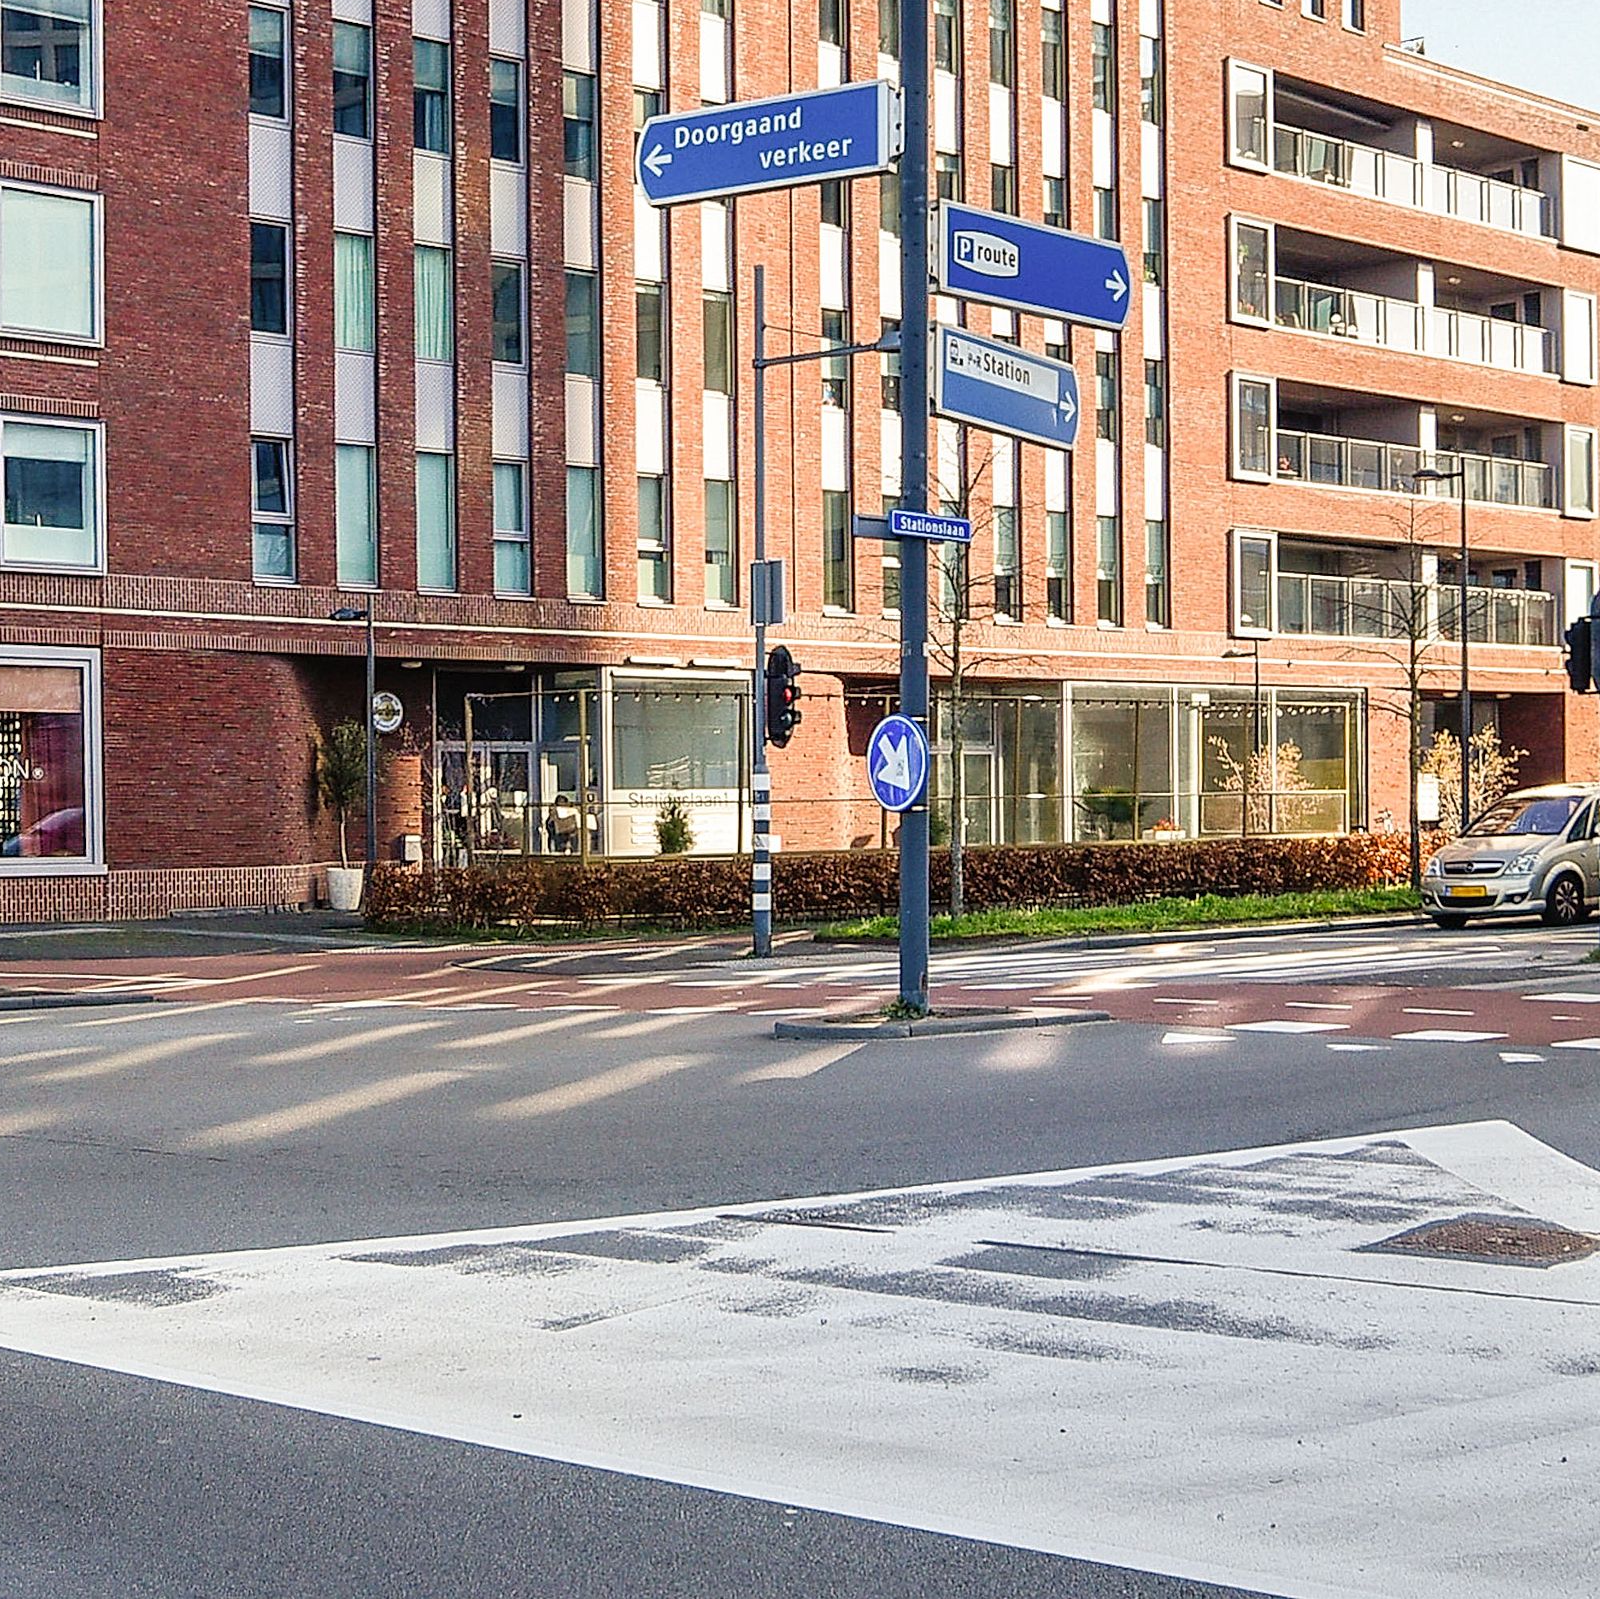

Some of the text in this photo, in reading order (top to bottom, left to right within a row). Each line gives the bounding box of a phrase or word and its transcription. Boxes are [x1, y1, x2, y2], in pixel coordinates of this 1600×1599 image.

[674, 105, 802, 149] Doorgaand
[759, 138, 853, 169] verkeer
[977, 246, 1016, 268] route
[983, 352, 1031, 385] Station
[900, 516, 965, 537] Stationslaan
